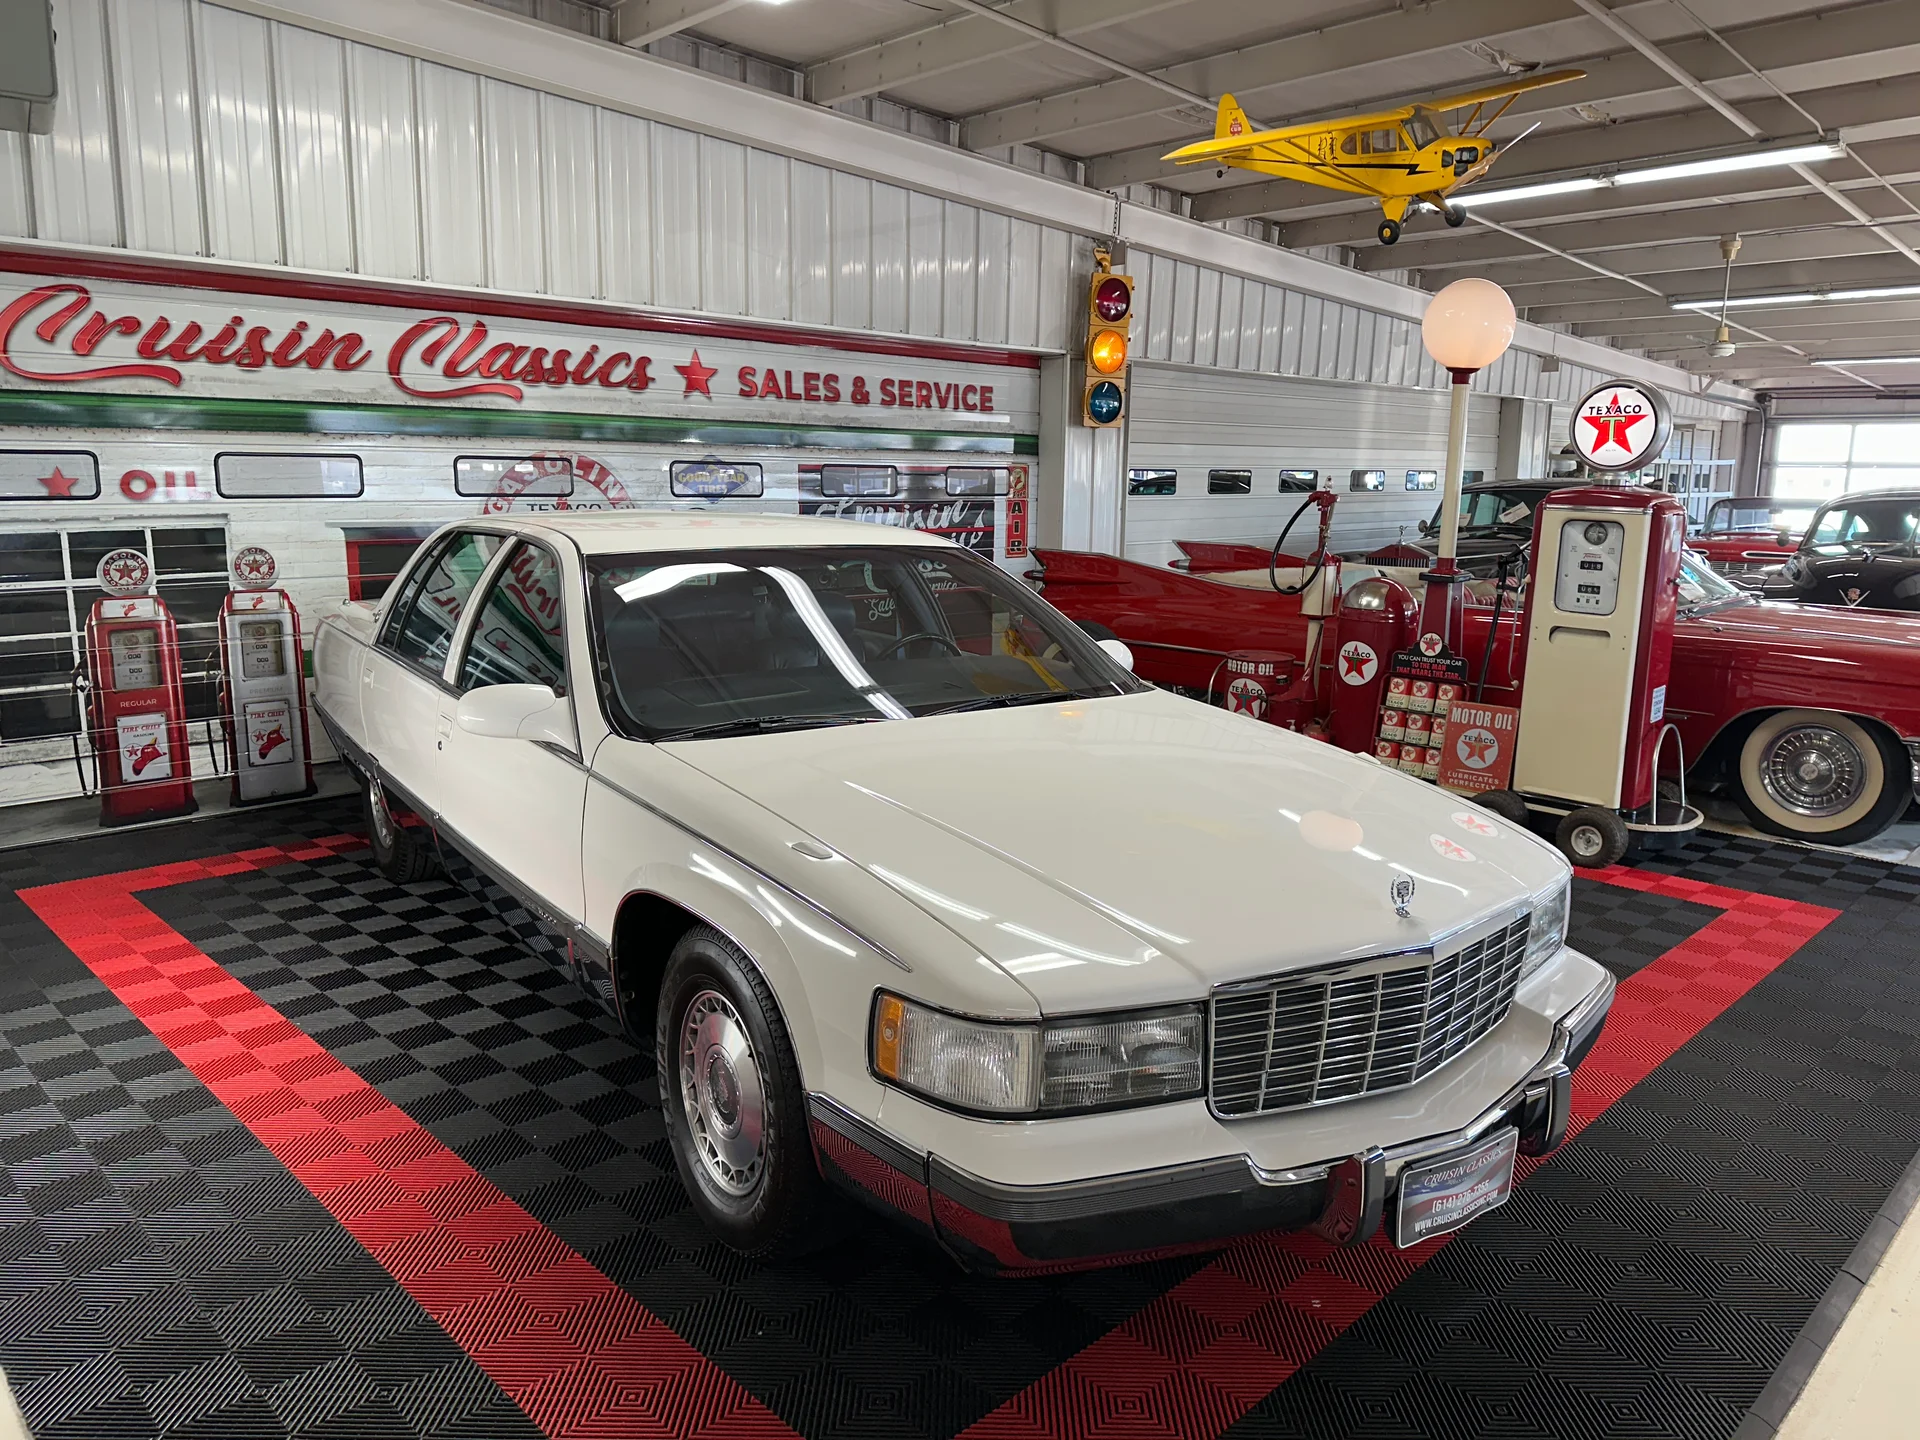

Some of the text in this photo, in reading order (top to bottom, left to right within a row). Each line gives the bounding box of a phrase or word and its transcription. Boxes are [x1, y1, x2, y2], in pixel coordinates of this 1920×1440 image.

[0, 283, 656, 401] Cruisin Classics
[738, 365, 994, 412] SALES & SERVICE
[1589, 404, 1642, 416] TEXACO
[119, 469, 211, 501] OIL
[486, 452, 636, 514] GASOLIN
[697, 484, 728, 494] TIRES
[1009, 501, 1024, 553] AIR
[104, 552, 147, 569] GASOLINE
[235, 548, 274, 564] GASOLINE
[1344, 650, 1371, 658] TEXACO
[1228, 658, 1274, 676] MOTOR OIL
[1396, 666, 1410, 674] THAT
[1411, 668, 1432, 677] WEARS
[1433, 670, 1444, 678] THE
[1232, 686, 1264, 695] TEXACO
[120, 698, 157, 708] REGULAR
[1451, 707, 1512, 730] MOTOR OIL
[122, 726, 139, 734] FIRE
[1463, 734, 1496, 745] TEXACO
[1447, 771, 1499, 784] LUBRICATES
[1448, 778, 1496, 790] PERFECTLY
[1424, 1166, 1466, 1186] CRUISIN
[1466, 1147, 1504, 1174] CLASSICS
[1432, 1195, 1456, 1214] (614)
